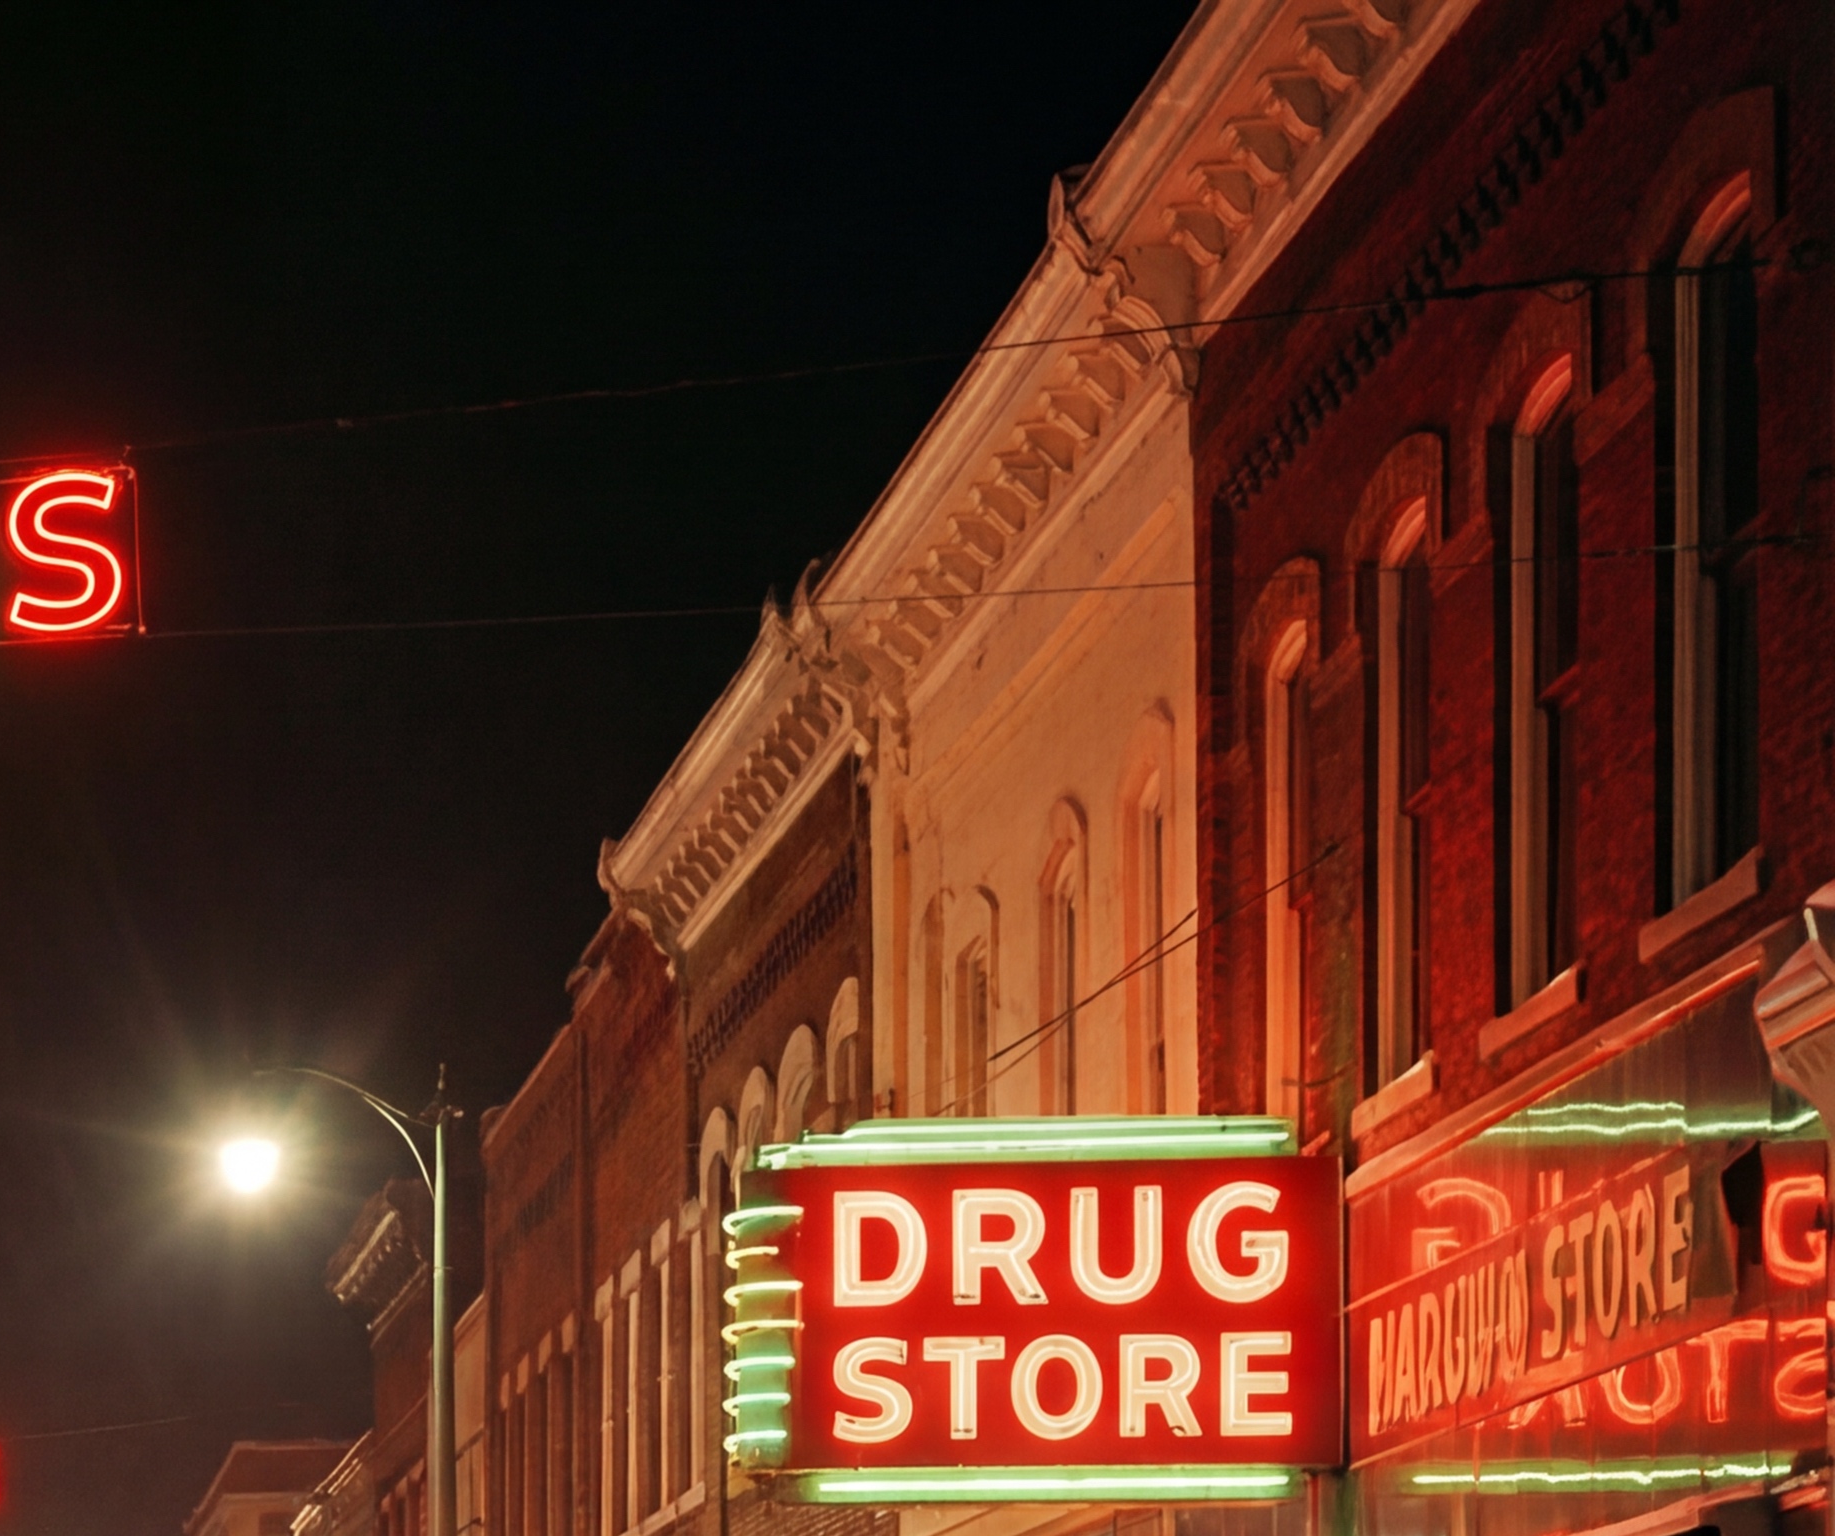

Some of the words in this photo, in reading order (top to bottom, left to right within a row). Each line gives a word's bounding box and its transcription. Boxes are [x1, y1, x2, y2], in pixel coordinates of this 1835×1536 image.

[832, 1182, 1291, 1308] DRUG
[1540, 1163, 1694, 1360] STORE
[832, 1329, 1295, 1443] STORE
